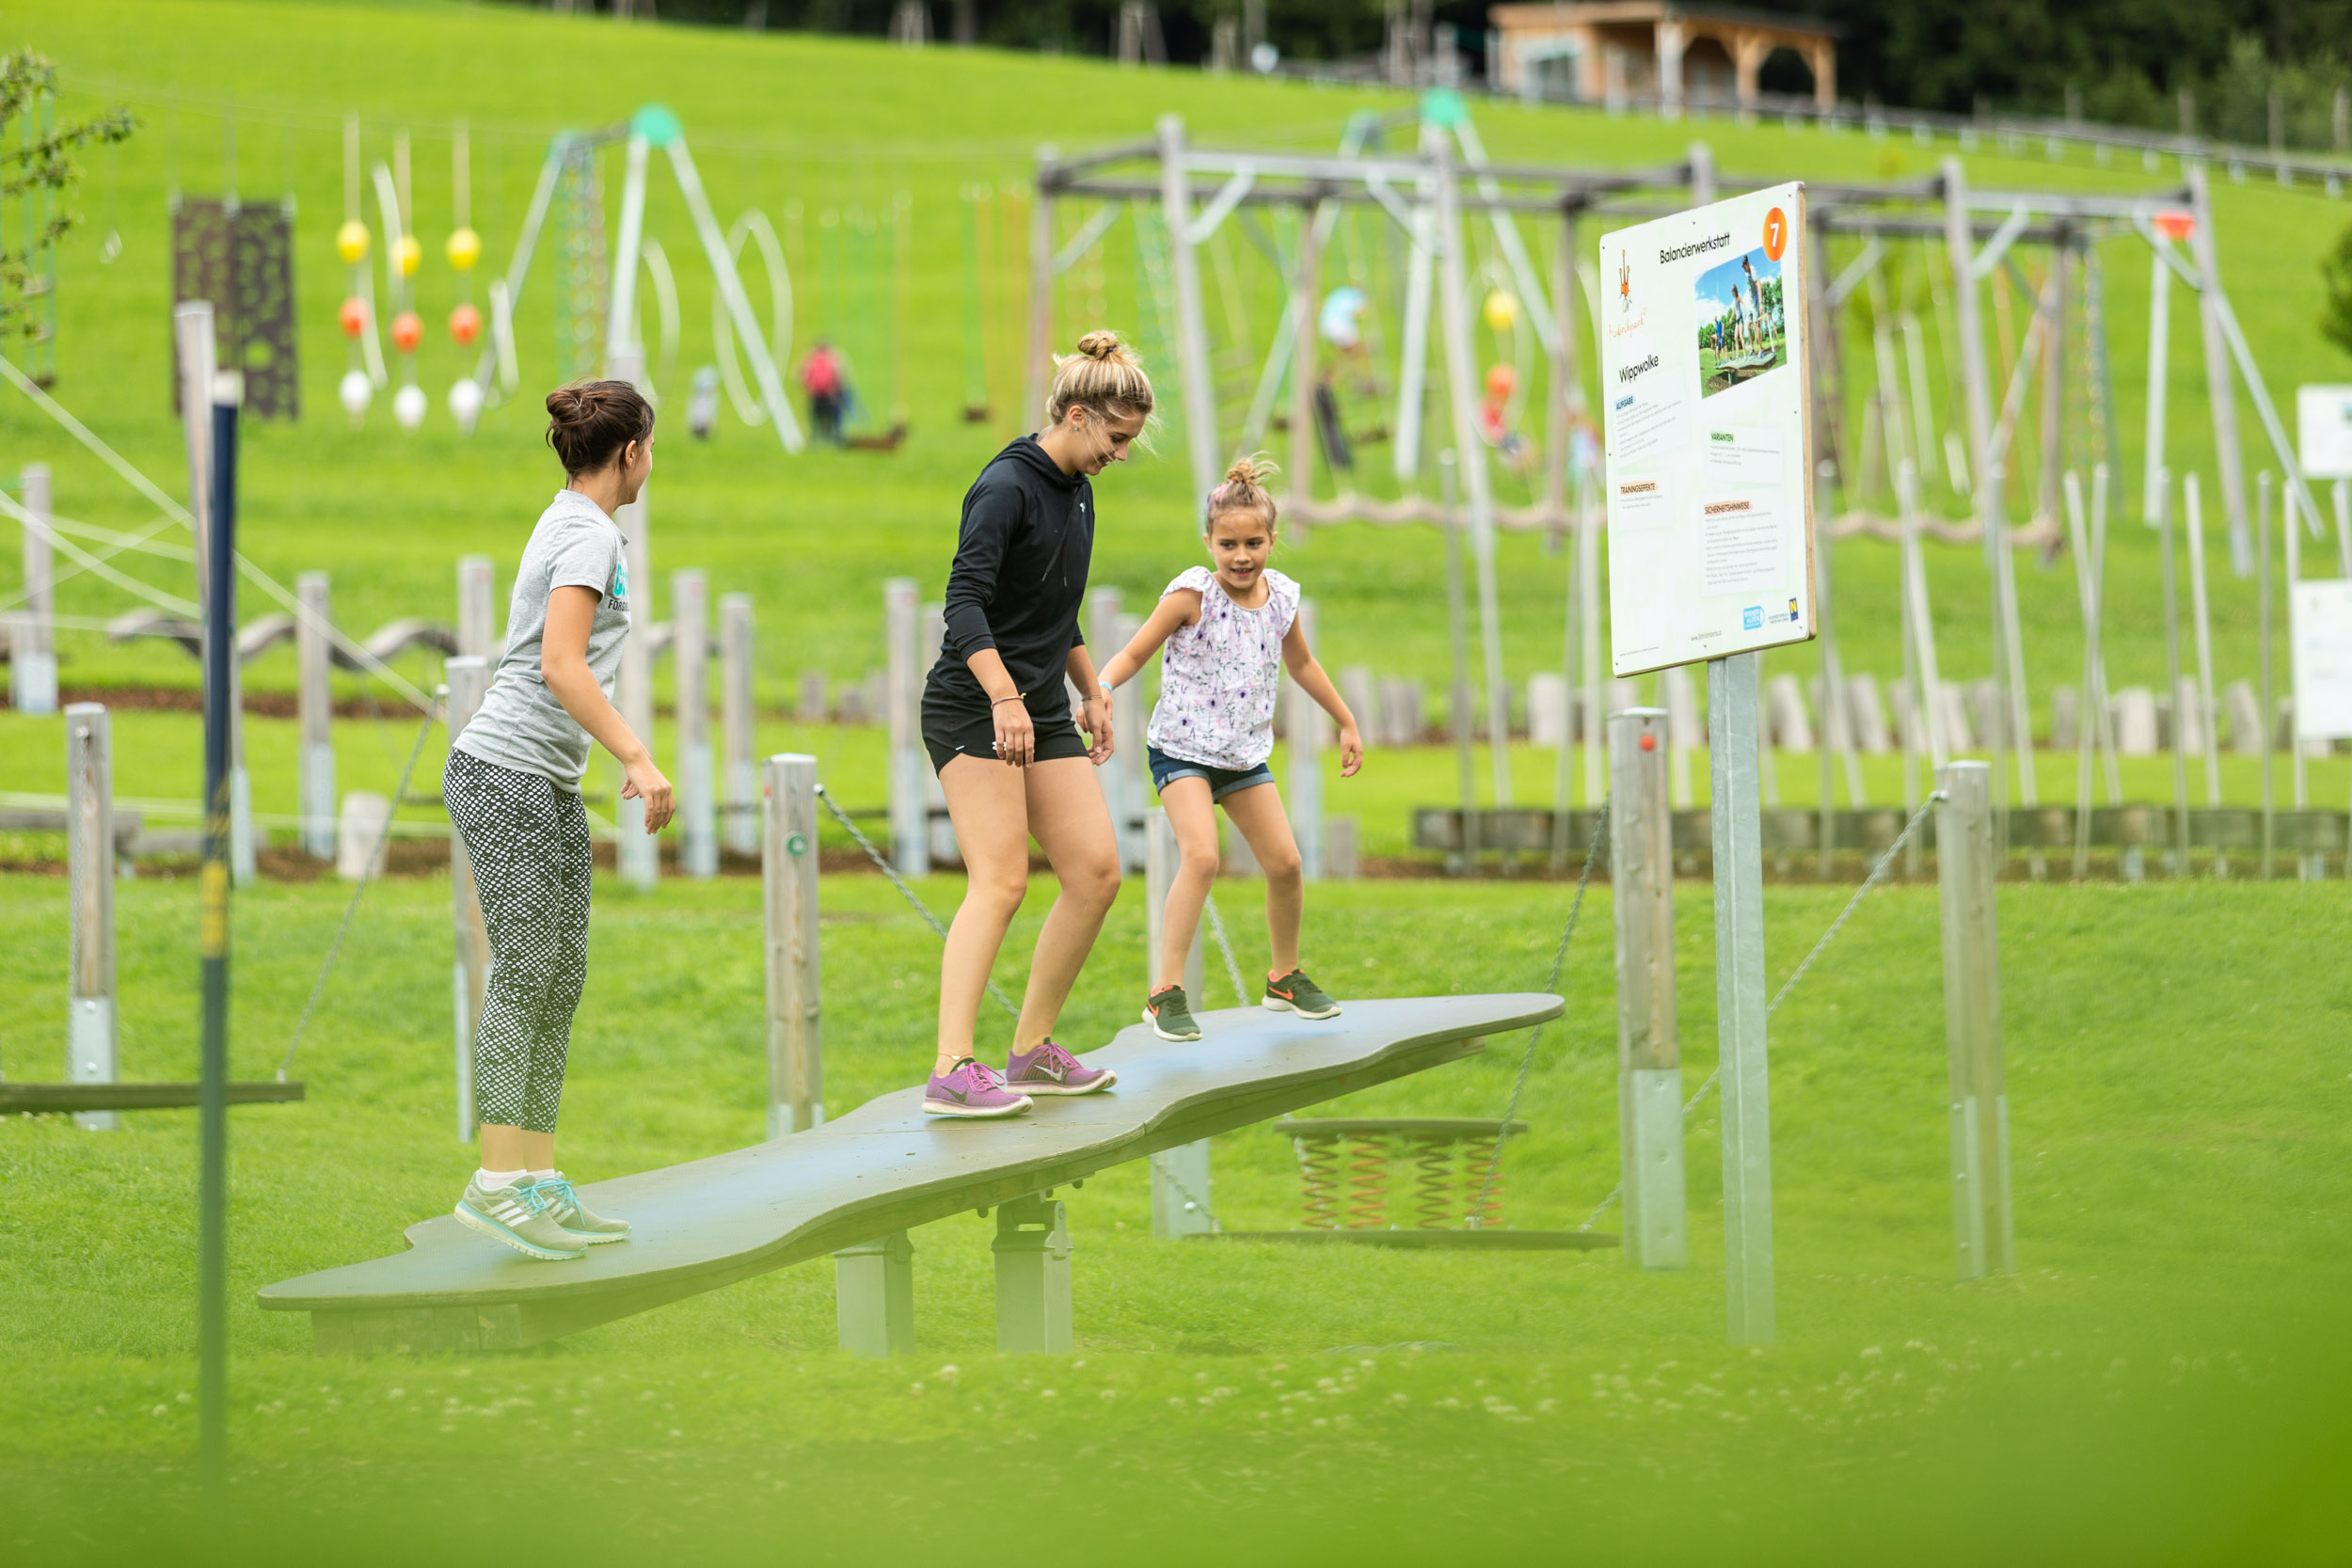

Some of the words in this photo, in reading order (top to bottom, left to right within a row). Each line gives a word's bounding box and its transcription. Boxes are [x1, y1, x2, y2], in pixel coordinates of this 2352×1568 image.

[1770, 222, 1779, 247] 7
[1660, 232, 1730, 264] Balancierwerkstatt
[1619, 354, 1659, 383] Wippwolke
[1616, 395, 1633, 410] AUFGABE
[1710, 432, 1734, 443] VARIANTEN
[1620, 483, 1656, 495] TRAININGSEFFEKTE
[1705, 501, 1750, 515] SICHERHEITSHINWEISE
[1789, 599, 1798, 614] N
